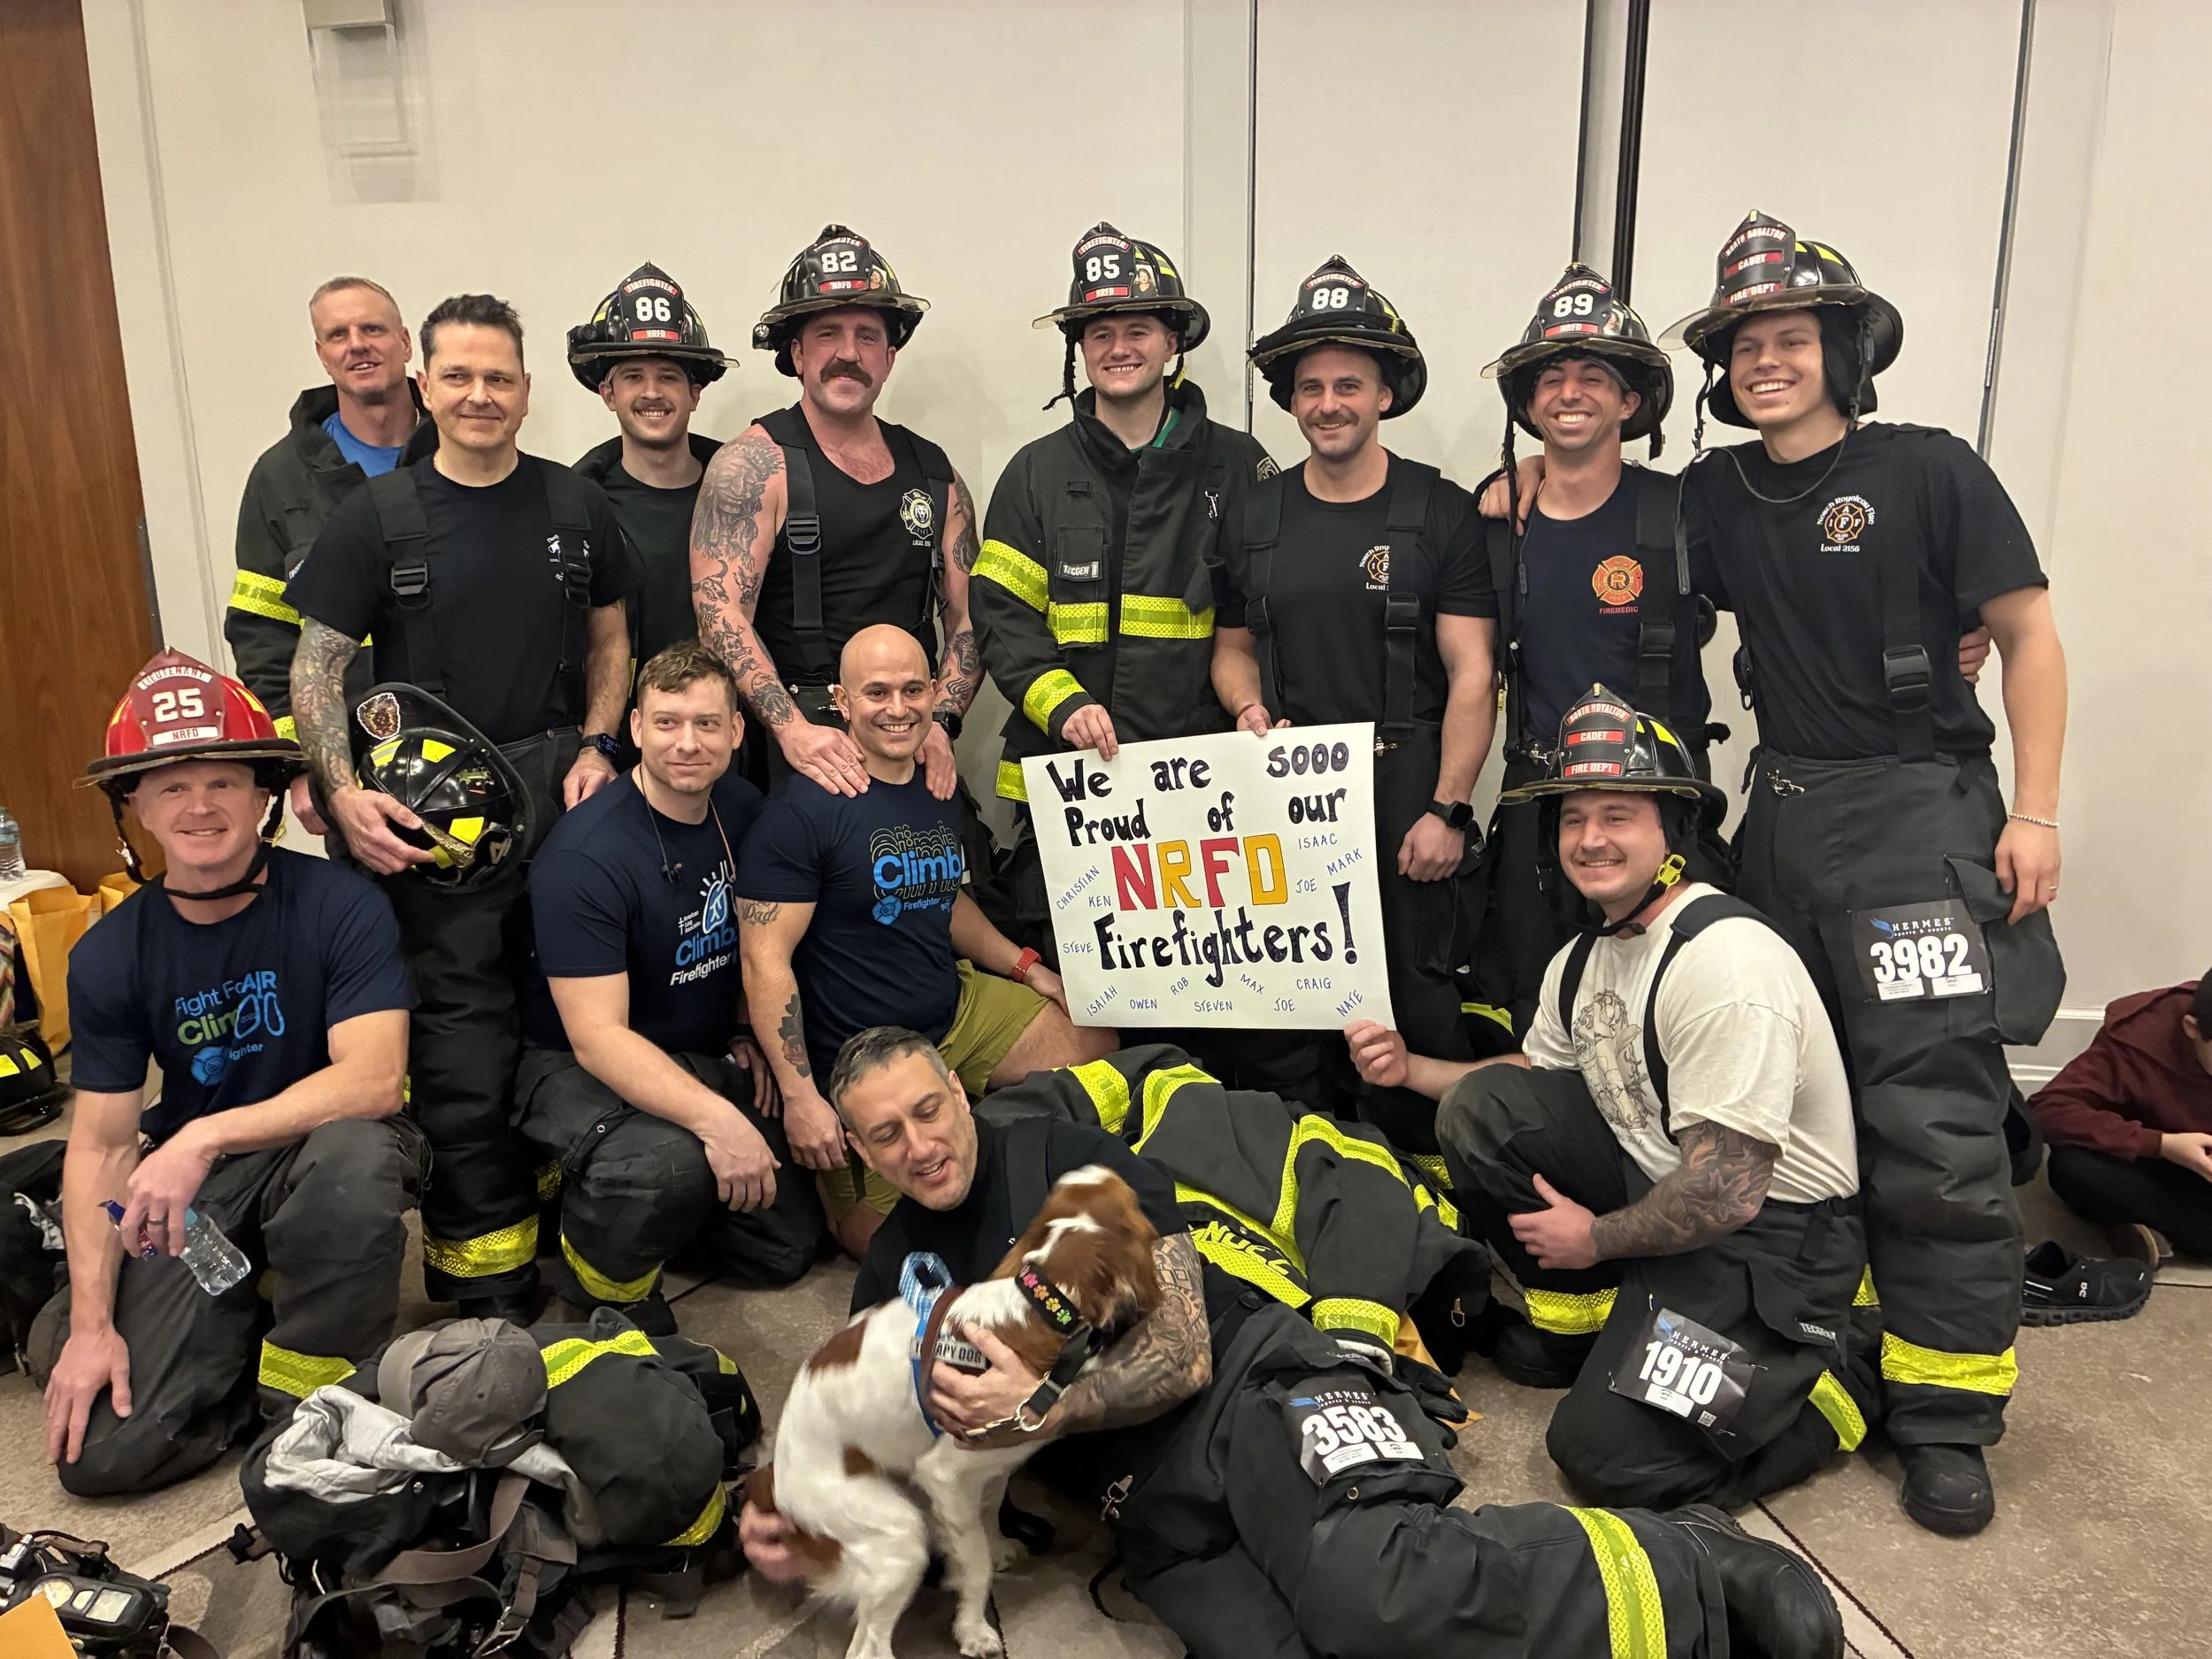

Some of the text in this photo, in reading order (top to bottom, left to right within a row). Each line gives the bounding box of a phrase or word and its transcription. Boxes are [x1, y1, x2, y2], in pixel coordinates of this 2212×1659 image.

[822, 251, 857, 273] 82
[1086, 254, 1119, 282] 85
[1739, 254, 1767, 270] CADET
[626, 278, 673, 294] FIREFIGHTER
[1730, 282, 1776, 303] FIRE DEPT
[636, 296, 671, 321] 86
[1312, 288, 1348, 310] 88
[1554, 294, 1594, 318] 89
[647, 329, 665, 338] NRFD
[1560, 323, 1583, 333] NRFD
[1820, 543, 1840, 552] Local
[141, 666, 207, 689] LIEUTENANT
[152, 687, 204, 723] 25
[1570, 703, 1625, 722] NORTH ROYALTON
[172, 728, 199, 741] NRFD
[1580, 731, 1609, 742] CADET
[1571, 763, 1613, 775] FIRE DEPT
[1046, 758, 1112, 803] We
[1151, 757, 1211, 792] are
[1064, 788, 1347, 847] Proud of our
[1298, 833, 1338, 850] ISAAC
[873, 846, 962, 889] Climb
[1110, 833, 1287, 910] NRFD
[1326, 847, 1363, 876] MARK
[1056, 865, 1100, 910] CHRISTIAN
[1294, 879, 1317, 893] JOE
[746, 902, 778, 921] Dad
[903, 897, 941, 910] Firefighter
[1089, 895, 1111, 908] KEN
[1893, 918, 1950, 932] HERMES
[676, 926, 736, 966] Climb
[1063, 941, 1094, 954] STEVE
[1870, 933, 1972, 983] 3982
[670, 953, 731, 986] Firefighter
[175, 988, 223, 1017] Fight
[240, 971, 277, 999] AIR
[1171, 976, 1189, 995] ROB
[1240, 973, 1264, 995] MAX
[1296, 978, 1332, 990] CRAIG
[1087, 985, 1118, 1017] ISAIAH
[1130, 998, 1157, 1010] OWEN
[1194, 1000, 1233, 1012] STEVEN
[1274, 998, 1295, 1012] JOE
[1336, 990, 1363, 1018] NATE
[959, 1348, 981, 1363] DOG
[1672, 1331, 1727, 1360] HERMES
[1639, 1340, 1723, 1405] 1910
[1315, 1391, 1368, 1402] HERMES
[1302, 1405, 1407, 1455] 3583
